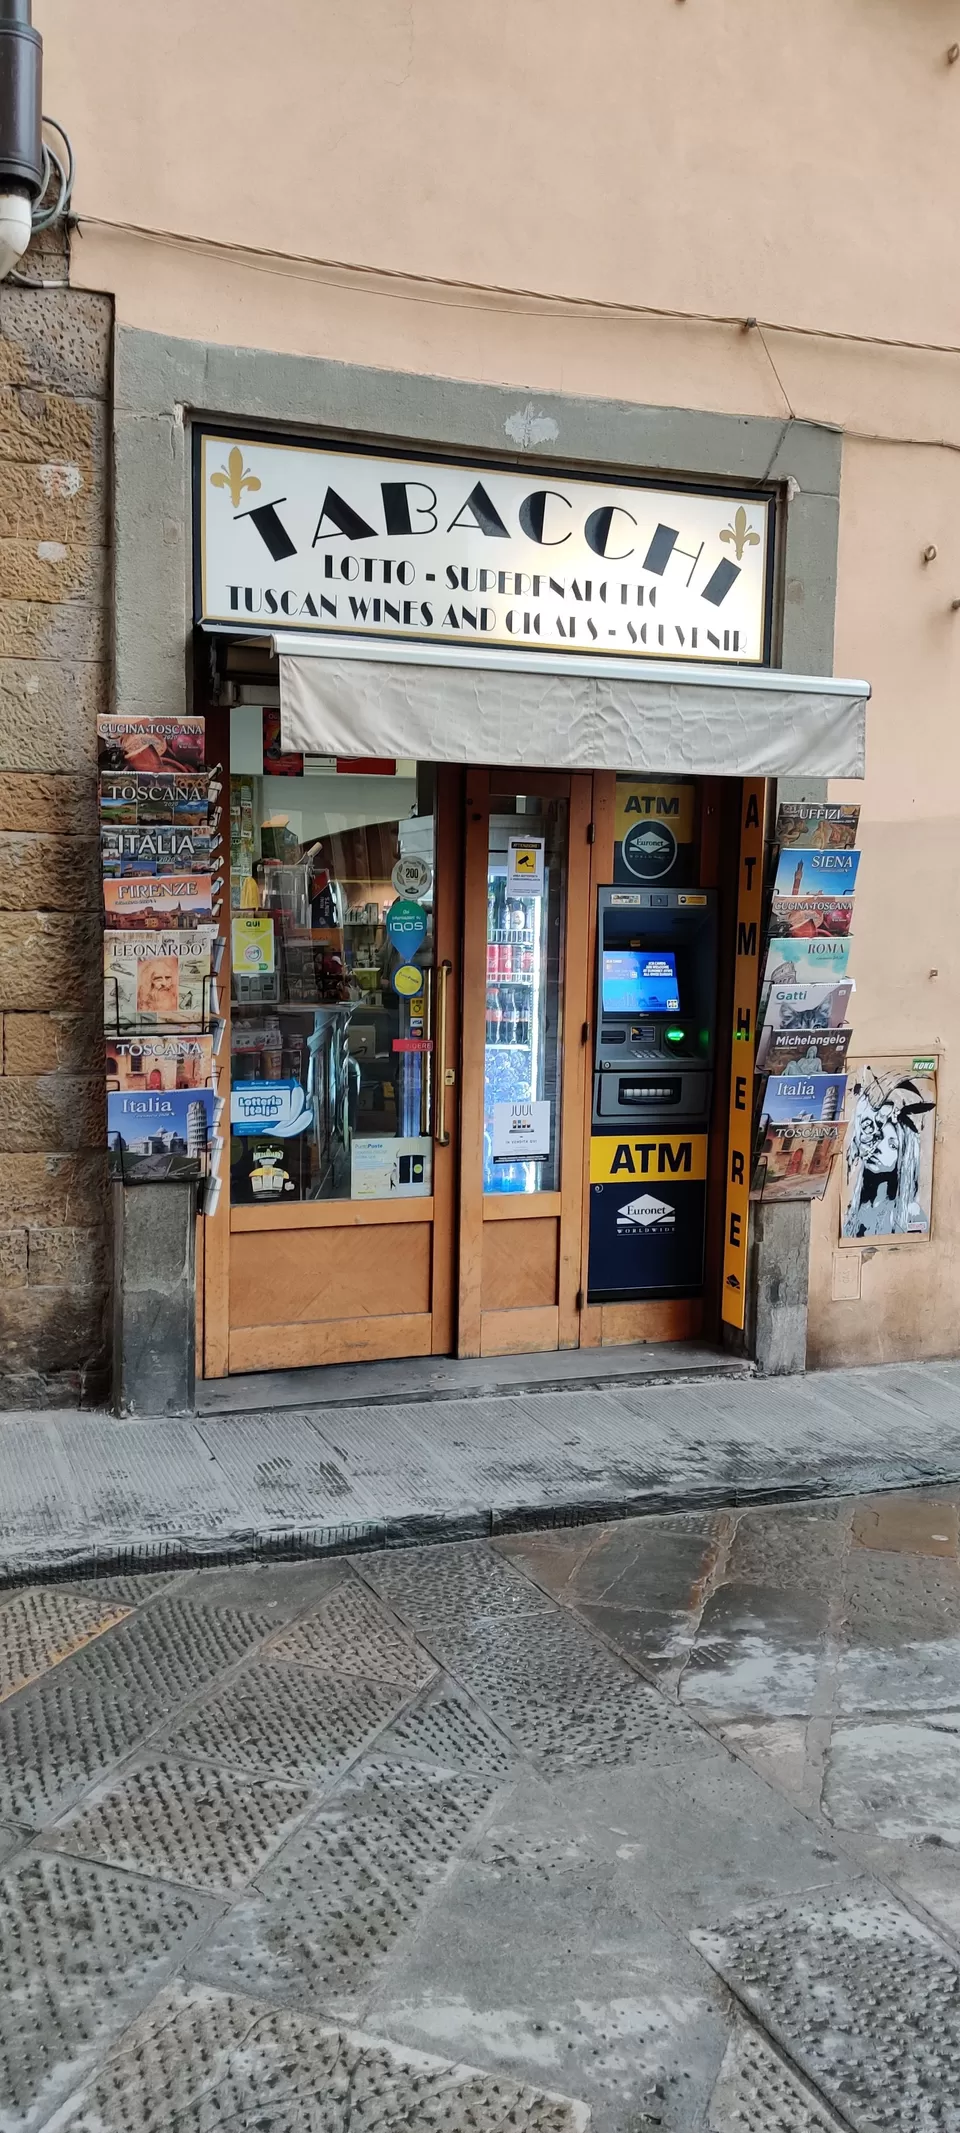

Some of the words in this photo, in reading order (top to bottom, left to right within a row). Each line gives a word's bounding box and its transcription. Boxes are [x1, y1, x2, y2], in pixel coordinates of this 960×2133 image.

[233, 480, 742, 607] TABACCHI
[325, 554, 415, 586] LOTTO
[226, 584, 338, 618] TUSCAN
[348, 596, 434, 627] WINES
[441, 603, 496, 631] AND
[100, 723, 145, 734] CUCINA
[149, 724, 203, 735] TOSCANA
[108, 786, 201, 801] TOSCANA
[623, 796, 680, 814] ATM
[800, 809, 841, 820] UFFIZI
[117, 834, 195, 854] ITALIA
[637, 838, 664, 846] Euronet
[811, 855, 853, 868] SIENA
[405, 868, 419, 879] 200
[738, 794, 759, 956] ATM
[118, 882, 198, 899] FIRENZE
[774, 902, 809, 911] CUCINA
[812, 902, 852, 911] TOSCANA
[389, 922, 424, 932] IQOS
[113, 943, 203, 957] LEONARDO
[807, 943, 845, 954] ROMA
[776, 991, 807, 1001] Gatti
[775, 1035, 846, 1046] Michelangelo
[116, 1043, 202, 1056] TOSCANA
[777, 1081, 815, 1096] Italia
[122, 1098, 172, 1114] Italia
[239, 1095, 283, 1107] Lotteria
[244, 1105, 279, 1117] Italia
[510, 1104, 533, 1117] JUUL
[730, 1007, 750, 1247] HERE
[775, 1127, 838, 1138] TOSCANA
[609, 1142, 692, 1174] ATM
[627, 1205, 666, 1216] Euronet
